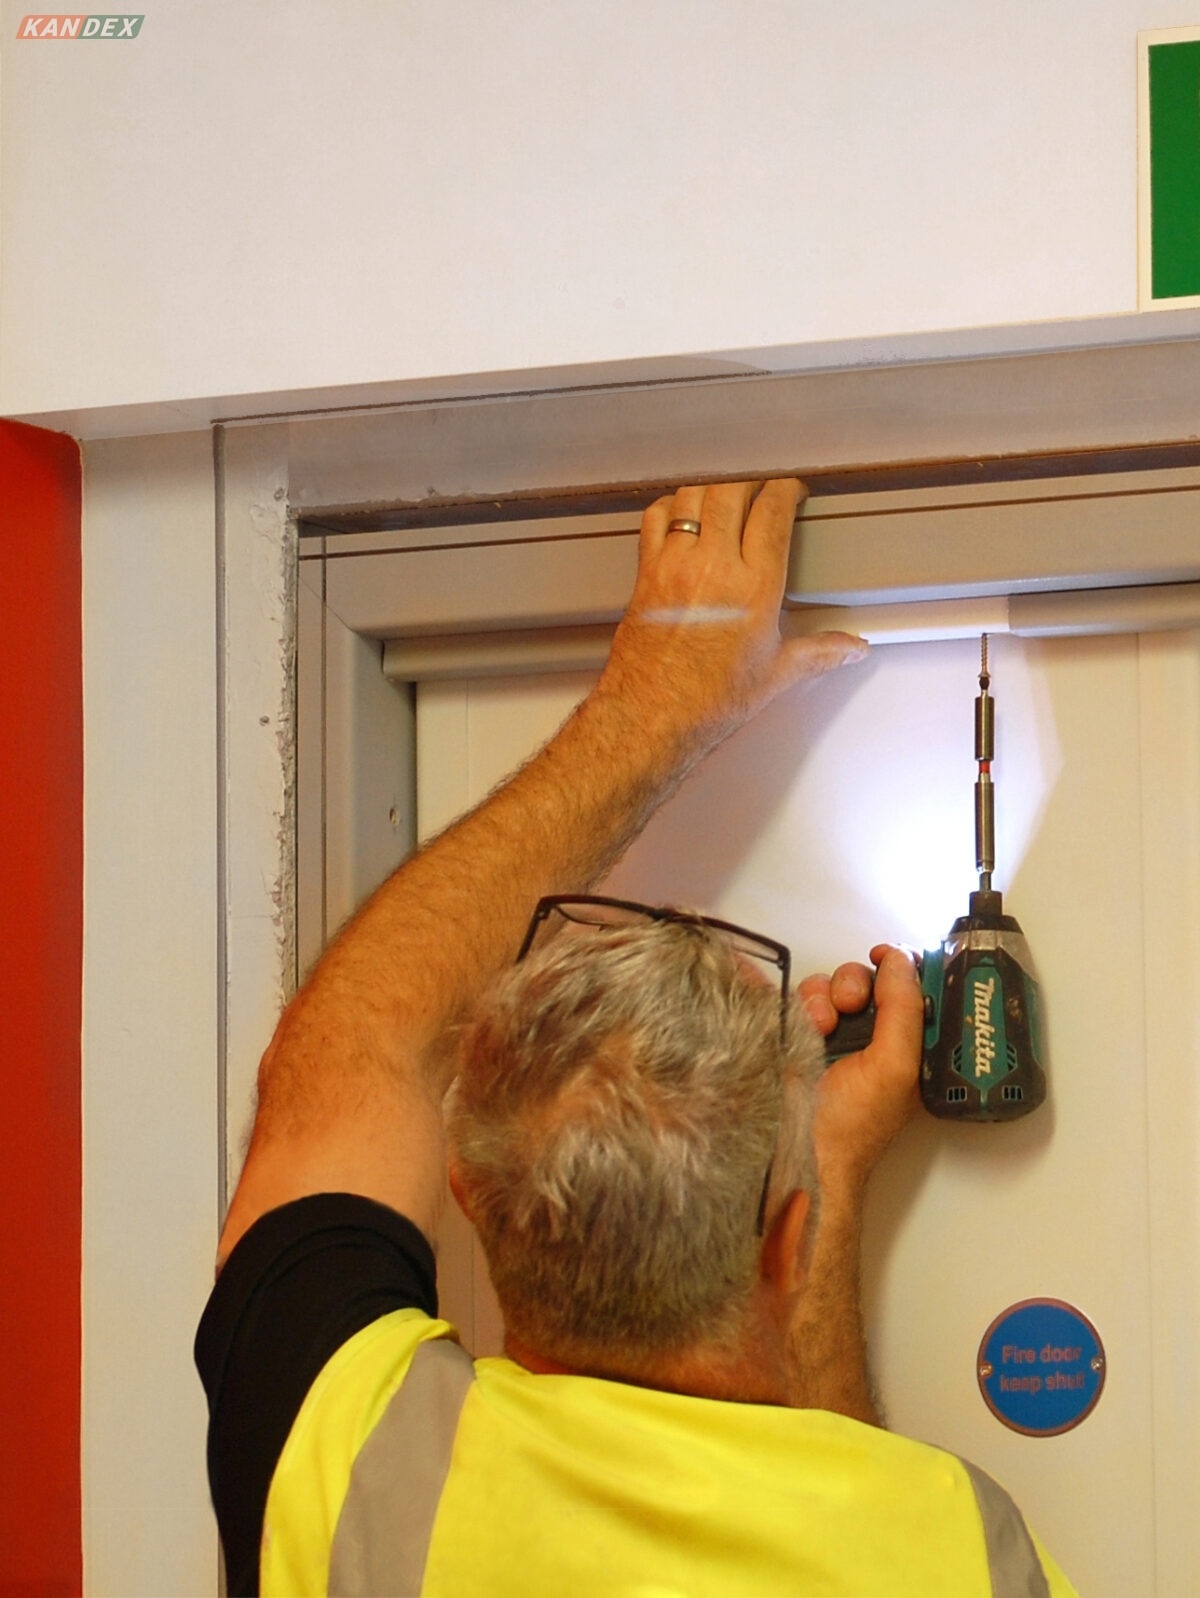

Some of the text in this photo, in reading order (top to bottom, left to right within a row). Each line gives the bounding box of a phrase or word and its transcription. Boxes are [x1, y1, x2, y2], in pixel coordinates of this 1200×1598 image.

[1001, 1343, 1082, 1364] Fire door
[1000, 1371, 1085, 1395] keep shut
